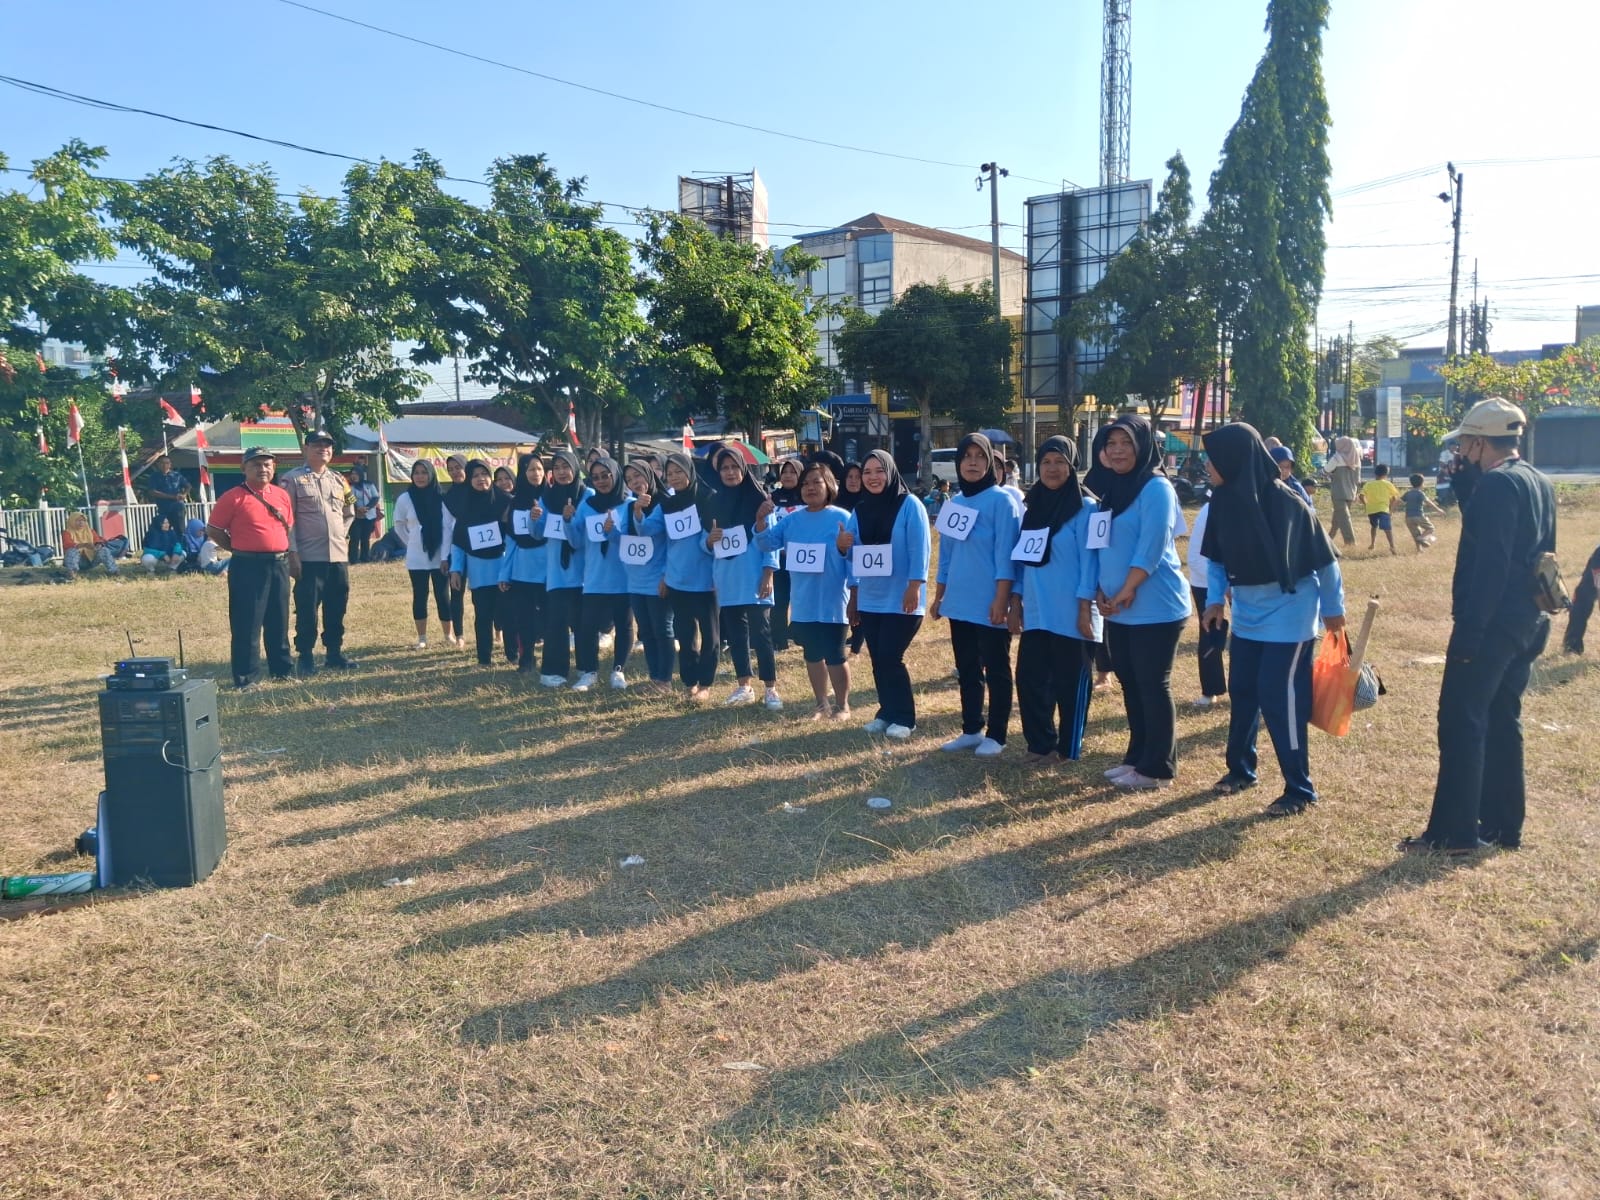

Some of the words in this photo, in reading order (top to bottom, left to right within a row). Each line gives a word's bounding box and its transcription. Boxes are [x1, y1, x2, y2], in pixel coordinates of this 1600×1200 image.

[674, 515, 693, 533] 07
[947, 512, 969, 532] 03
[477, 528, 495, 543] 12
[721, 534, 740, 550] 06
[627, 543, 647, 557] 08
[1023, 537, 1044, 555] 02
[795, 548, 816, 565] 05
[862, 552, 884, 569] 04
